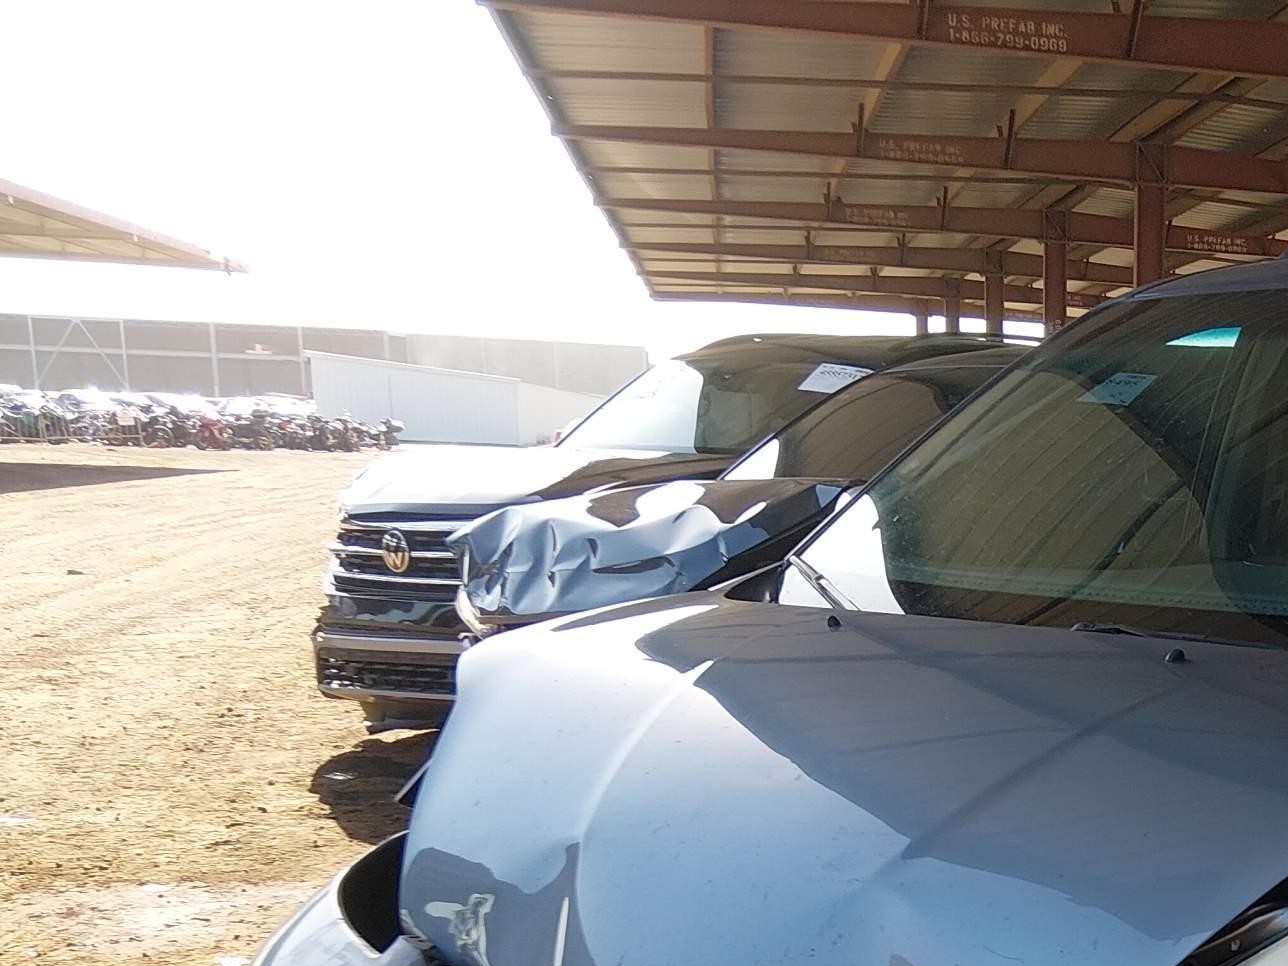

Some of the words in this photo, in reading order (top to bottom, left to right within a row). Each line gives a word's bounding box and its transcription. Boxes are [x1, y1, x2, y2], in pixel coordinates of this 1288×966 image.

[982, 15, 1035, 34] PREFAB
[1041, 21, 1069, 38] INC.
[949, 28, 1068, 52] 1-866-799-0969
